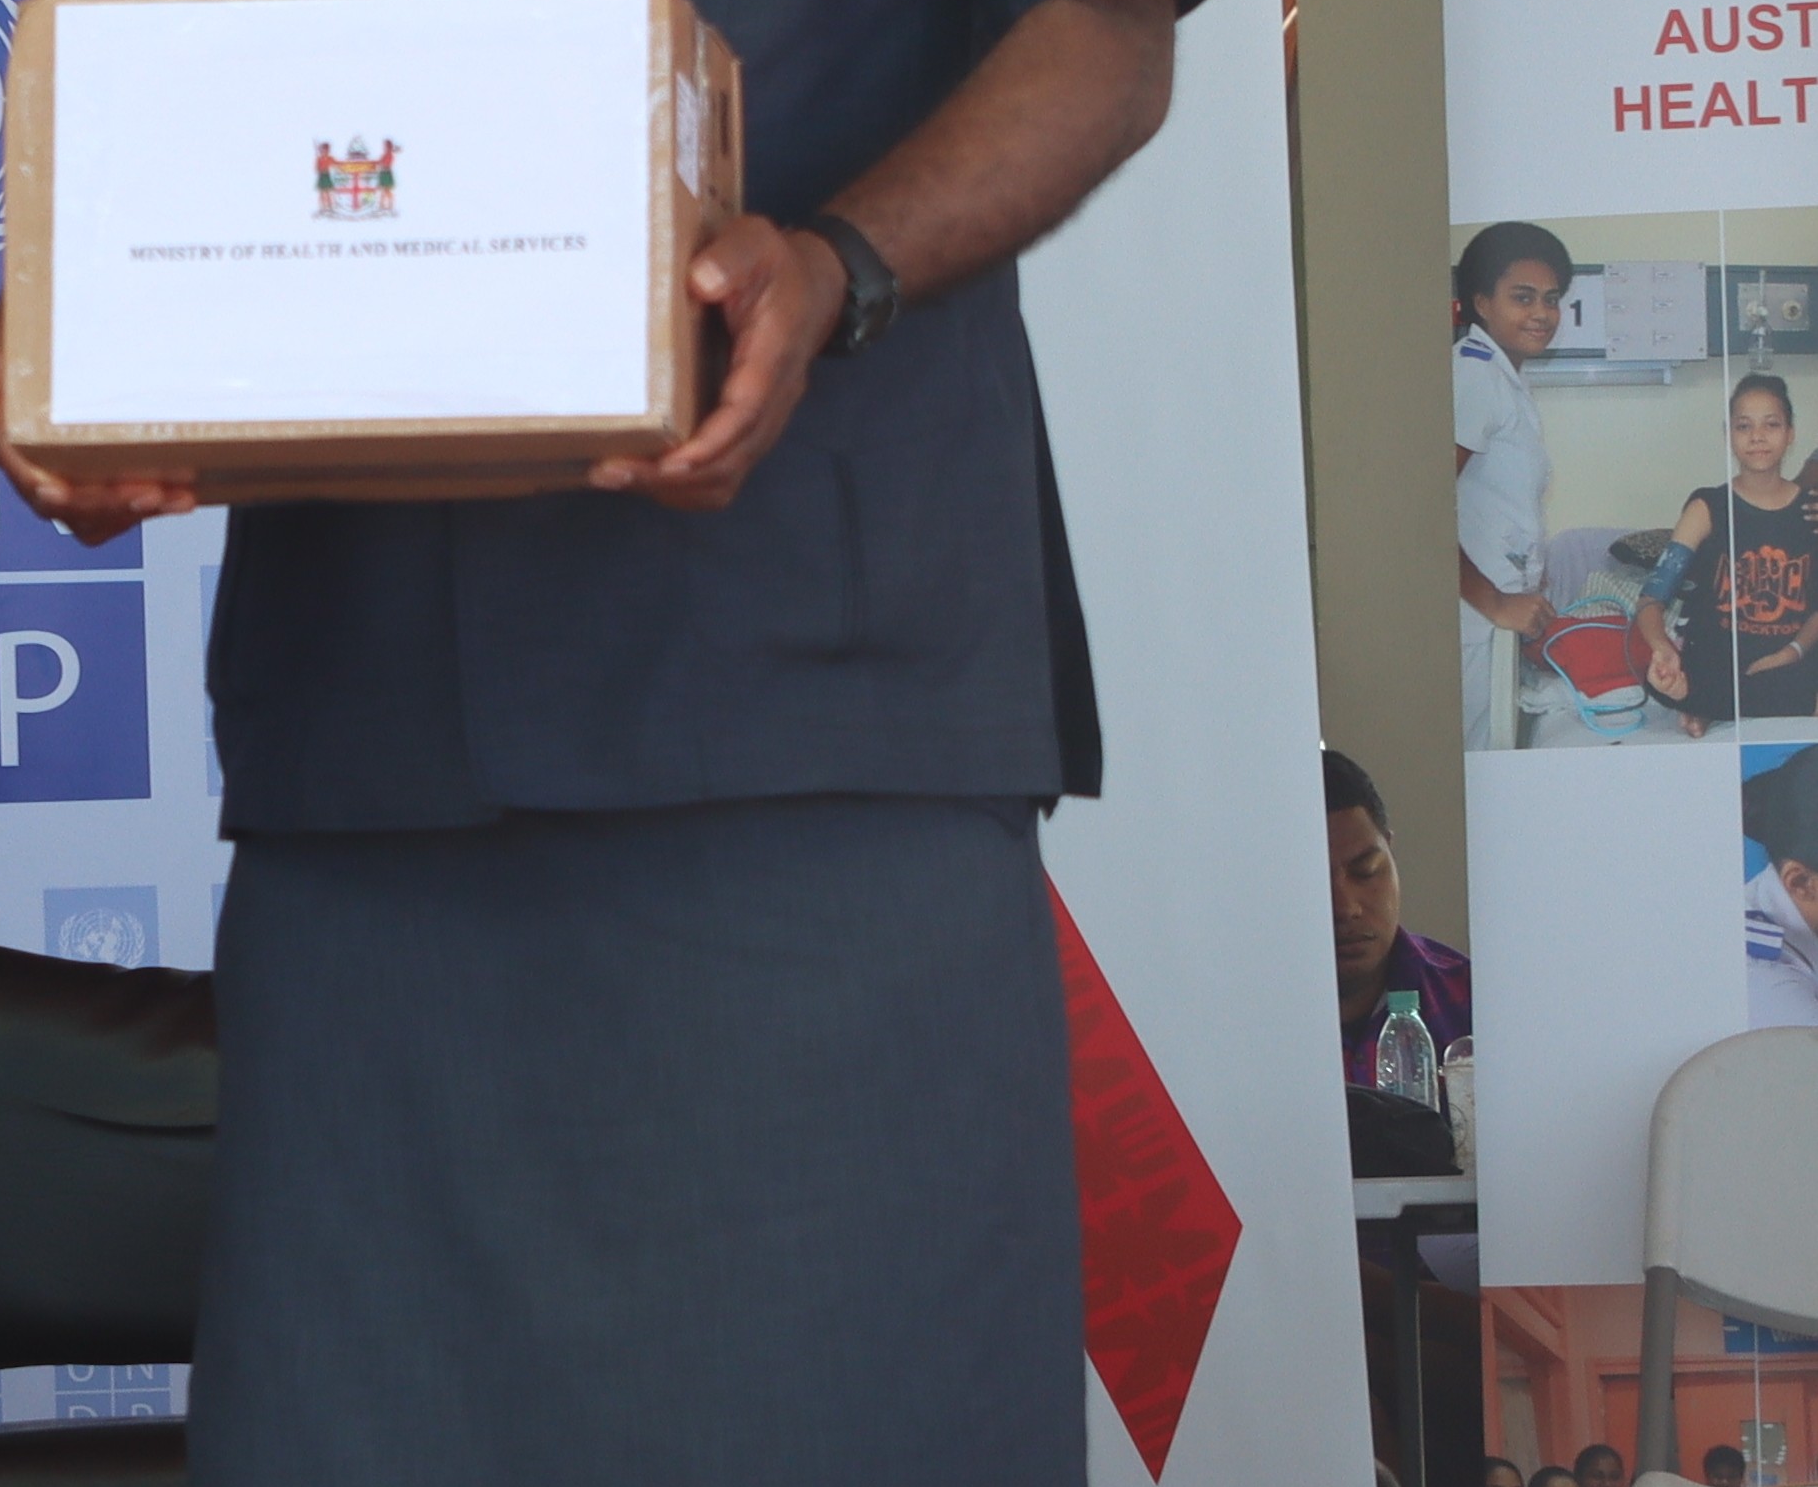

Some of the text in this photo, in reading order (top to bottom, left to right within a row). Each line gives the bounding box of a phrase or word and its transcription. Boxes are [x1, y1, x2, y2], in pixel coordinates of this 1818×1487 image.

[1654, 2, 1818, 56] AUST
[1614, 77, 1818, 132] HEALT
[129, 235, 587, 262] MINISTRY OF HEALTH AND MEDICAL SERVICES
[1569, 299, 1582, 327] 1
